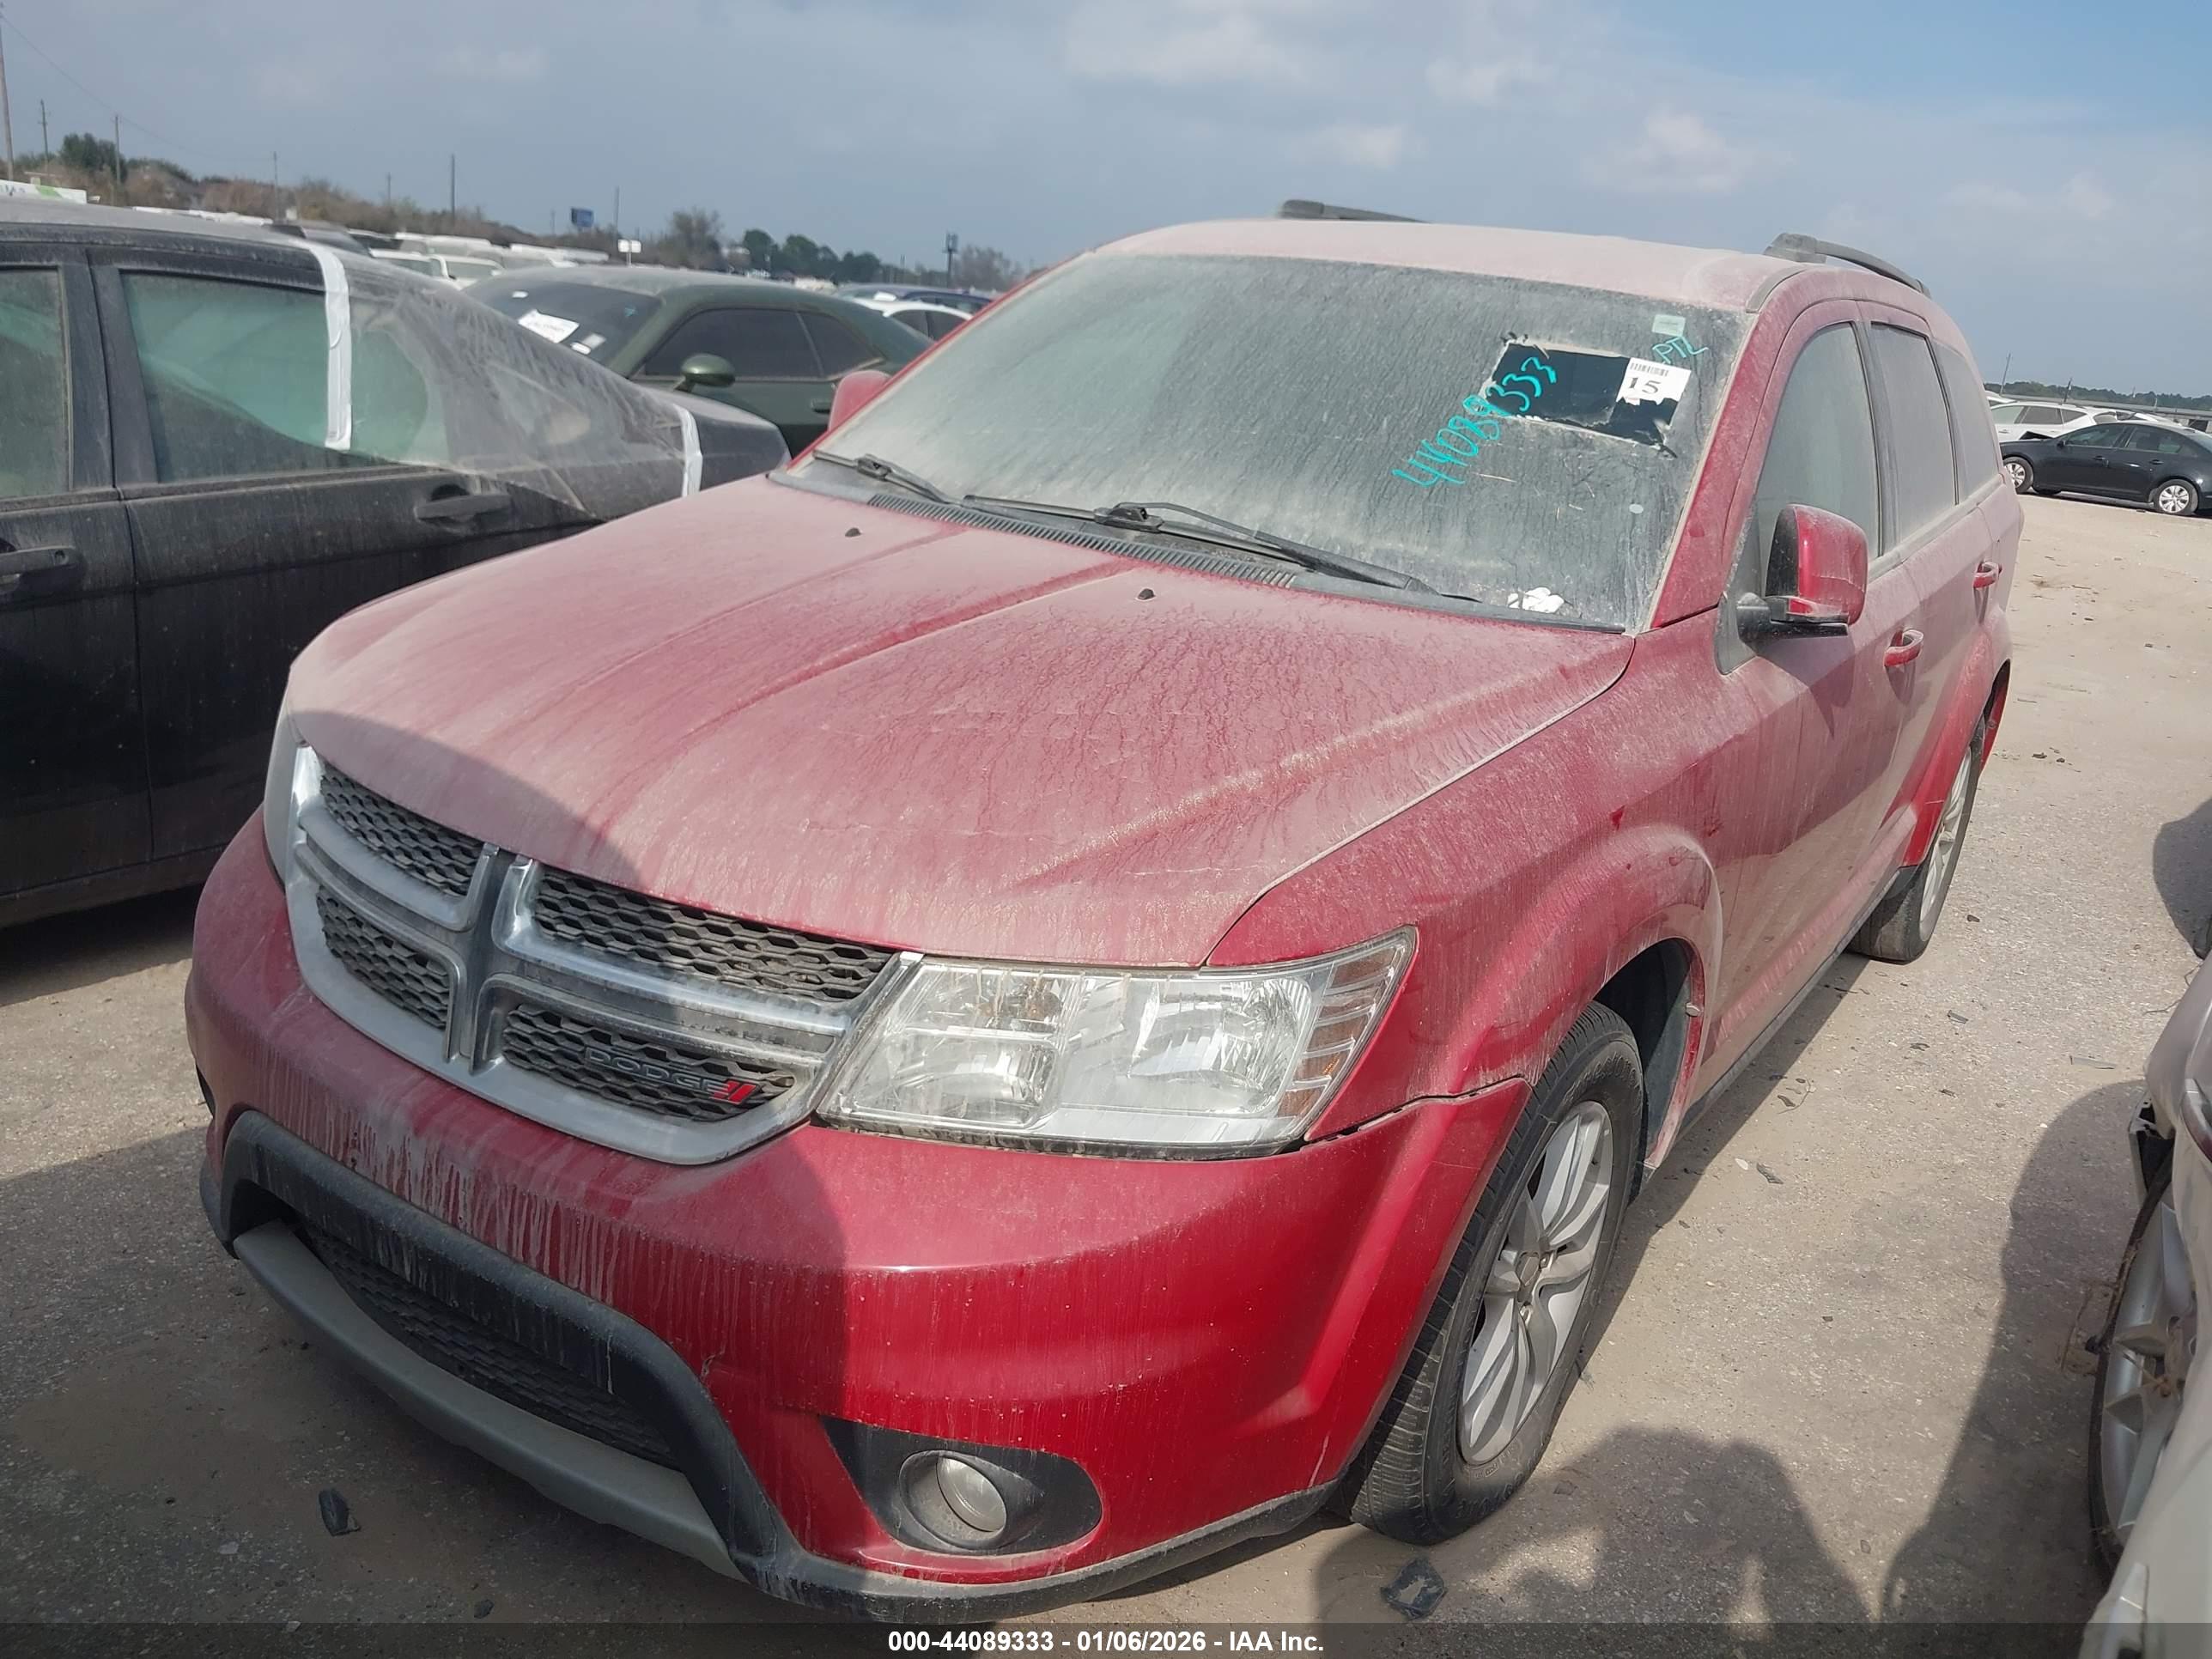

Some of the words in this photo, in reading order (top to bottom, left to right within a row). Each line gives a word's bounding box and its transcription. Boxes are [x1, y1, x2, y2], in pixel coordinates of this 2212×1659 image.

[1629, 376, 1662, 395] 15
[1391, 356, 1557, 488] 44089333
[585, 1047, 732, 1098] DODGE
